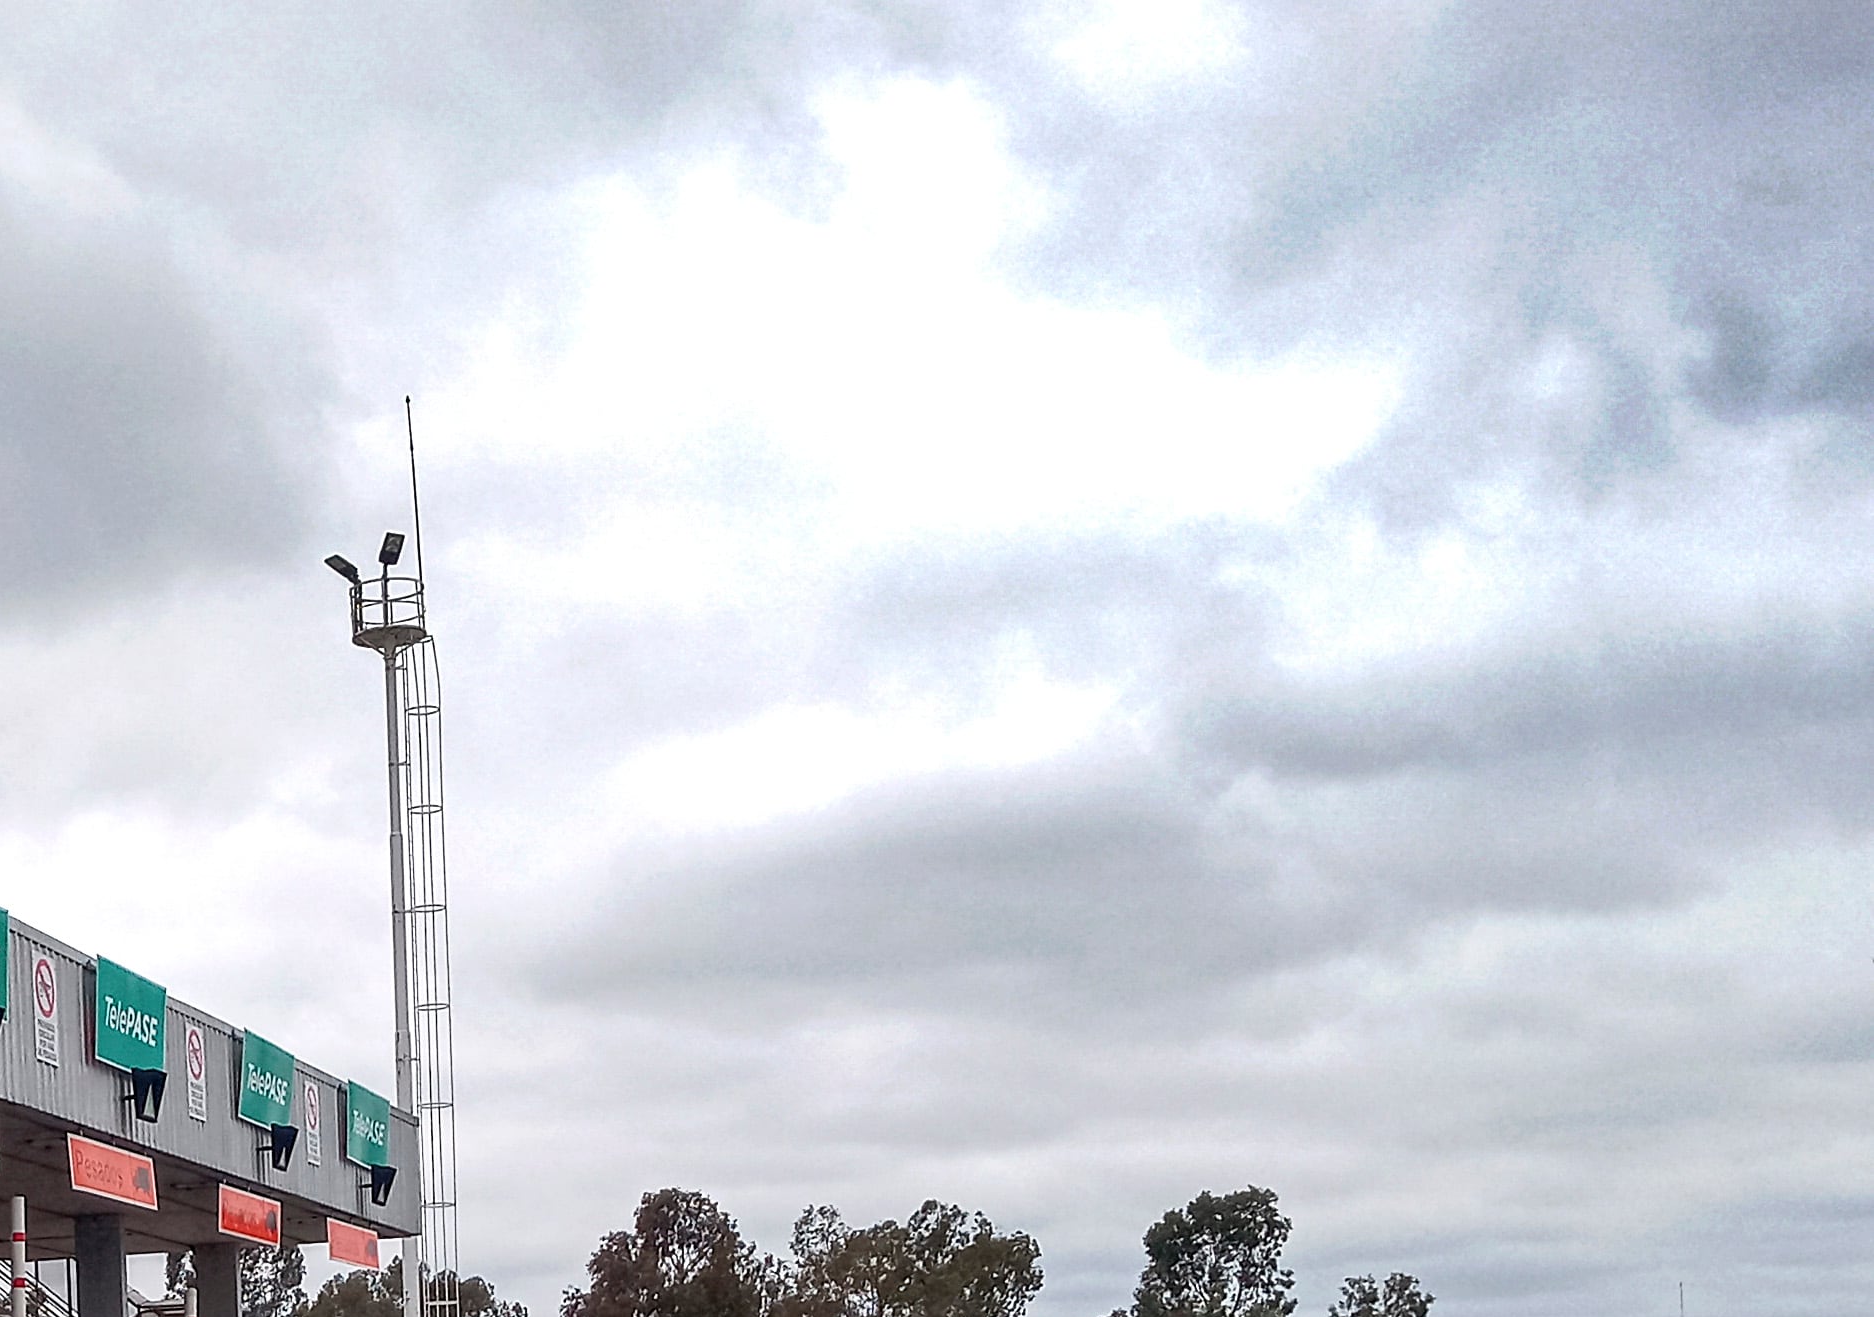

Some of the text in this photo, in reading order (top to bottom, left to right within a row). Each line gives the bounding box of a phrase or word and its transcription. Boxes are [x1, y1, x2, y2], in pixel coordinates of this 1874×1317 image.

[104, 995, 159, 1048] TelePASE
[245, 1063, 289, 1107] TelePASE
[352, 1110, 386, 1146] TelePASE
